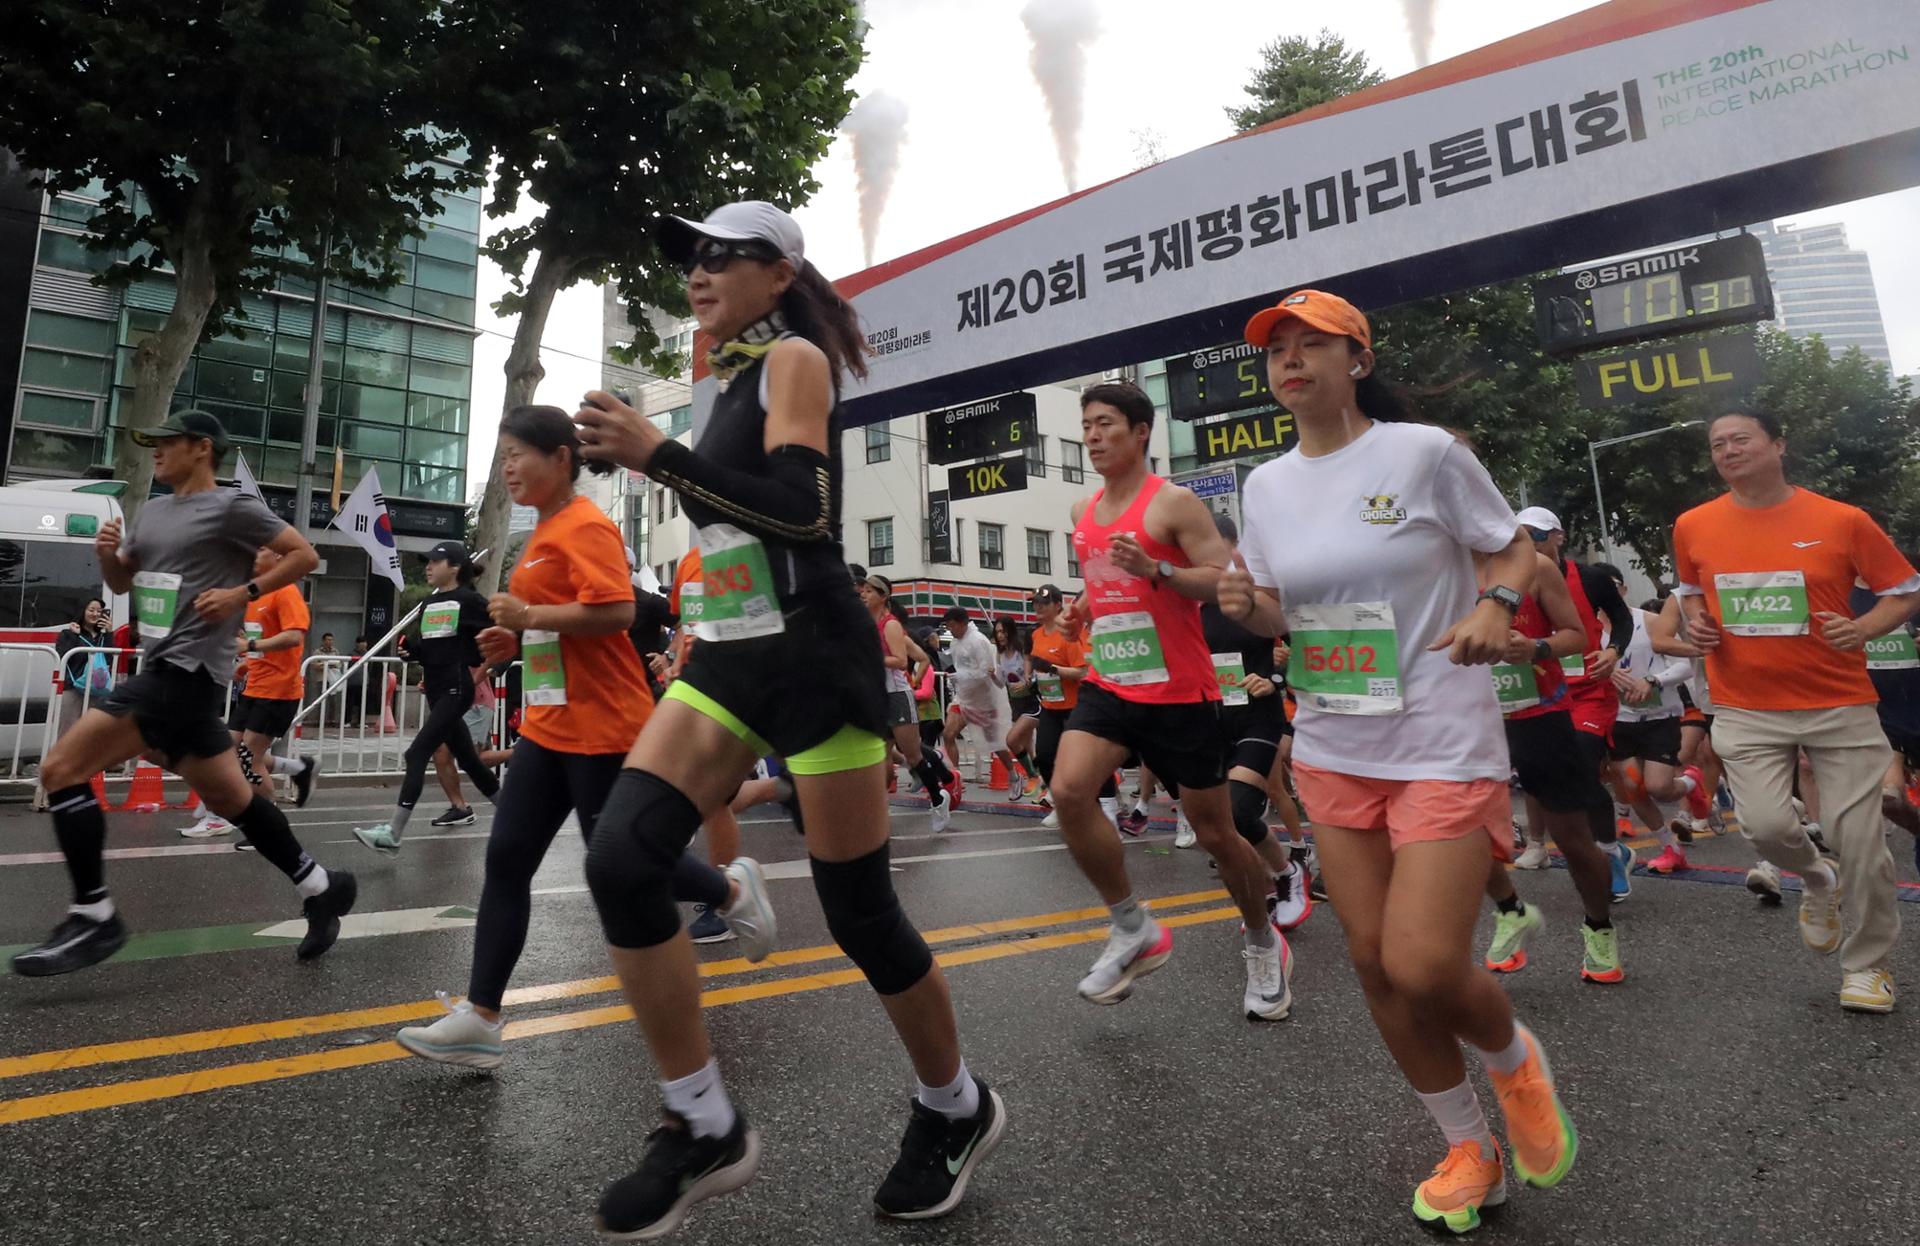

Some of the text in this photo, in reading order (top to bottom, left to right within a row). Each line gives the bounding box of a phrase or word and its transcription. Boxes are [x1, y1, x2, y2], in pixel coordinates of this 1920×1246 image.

[1653, 45, 1765, 89] THE 20th
[1656, 38, 1866, 110] INTERNATIONAL
[1660, 45, 1910, 129] PEACE MARATHON
[956, 79, 1648, 333] 제20회 국제평화마라톤대회
[1599, 248, 1701, 284] SAMIK
[867, 326, 898, 345] 제20회
[1599, 347, 1734, 398] FULL
[956, 400, 1000, 421] SAMIK
[1207, 413, 1293, 457] HALF
[966, 463, 1008, 493] 10K
[1731, 594, 1793, 613] 11422
[1098, 637, 1151, 662] 10636
[1302, 645, 1377, 673] 15612
[1865, 640, 1905, 654] 0601
